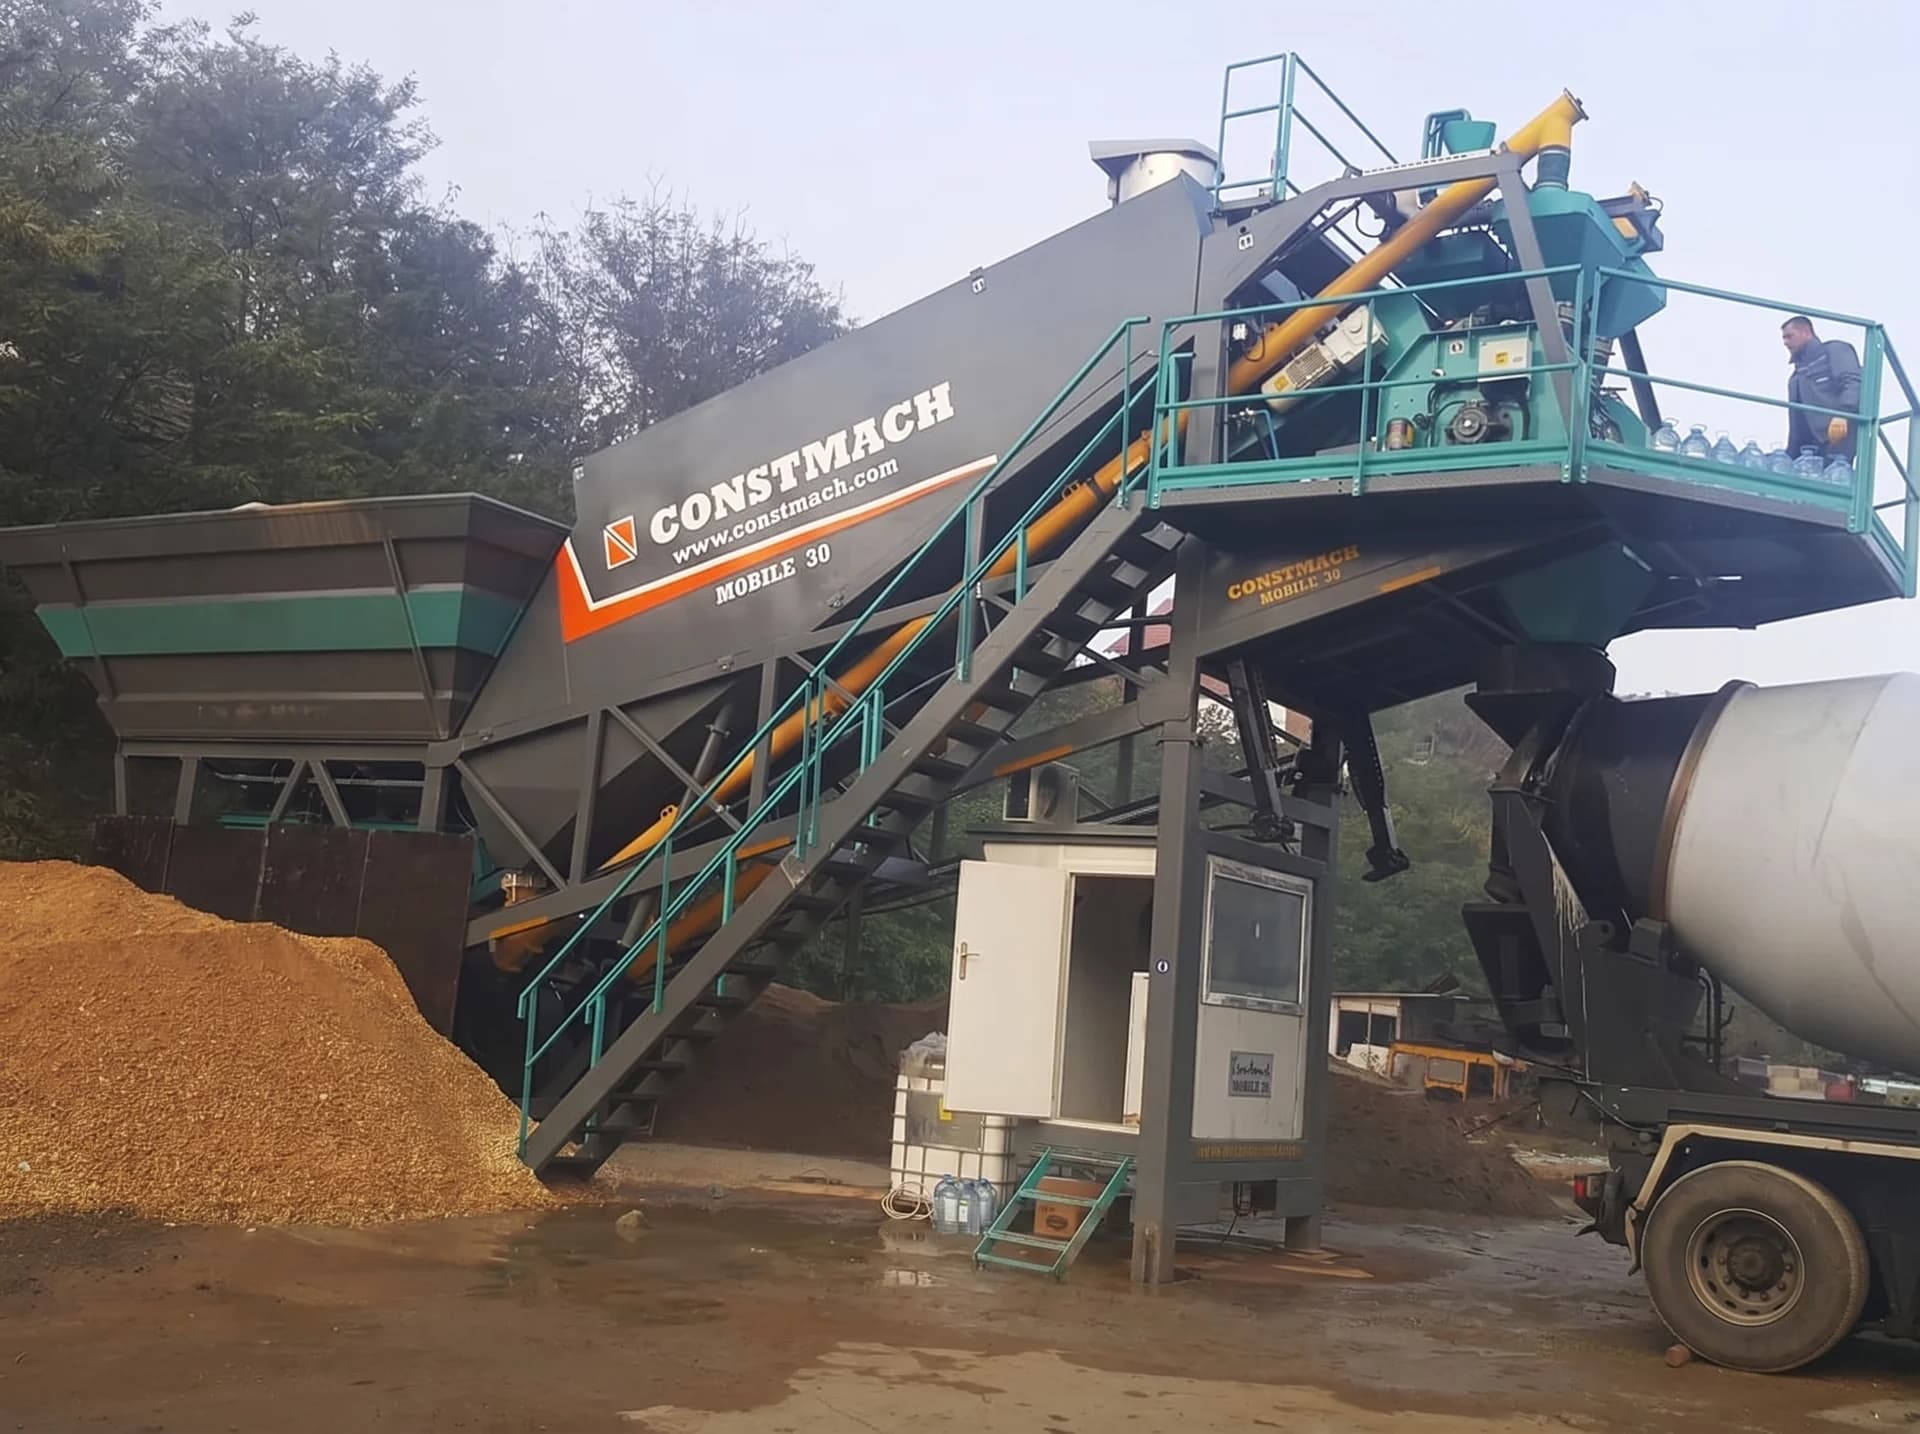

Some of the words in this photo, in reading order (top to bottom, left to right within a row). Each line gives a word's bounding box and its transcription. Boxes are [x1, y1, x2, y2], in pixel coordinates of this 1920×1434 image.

[650, 382, 954, 544] CONSTMACH
[672, 458, 899, 565] www.constmach.com
[715, 558, 796, 605] MOBILE
[805, 543, 832, 568] 30
[1227, 545, 1360, 600] CONSTMACH
[1261, 577, 1318, 604] MOBILE
[1324, 568, 1341, 584] 30
